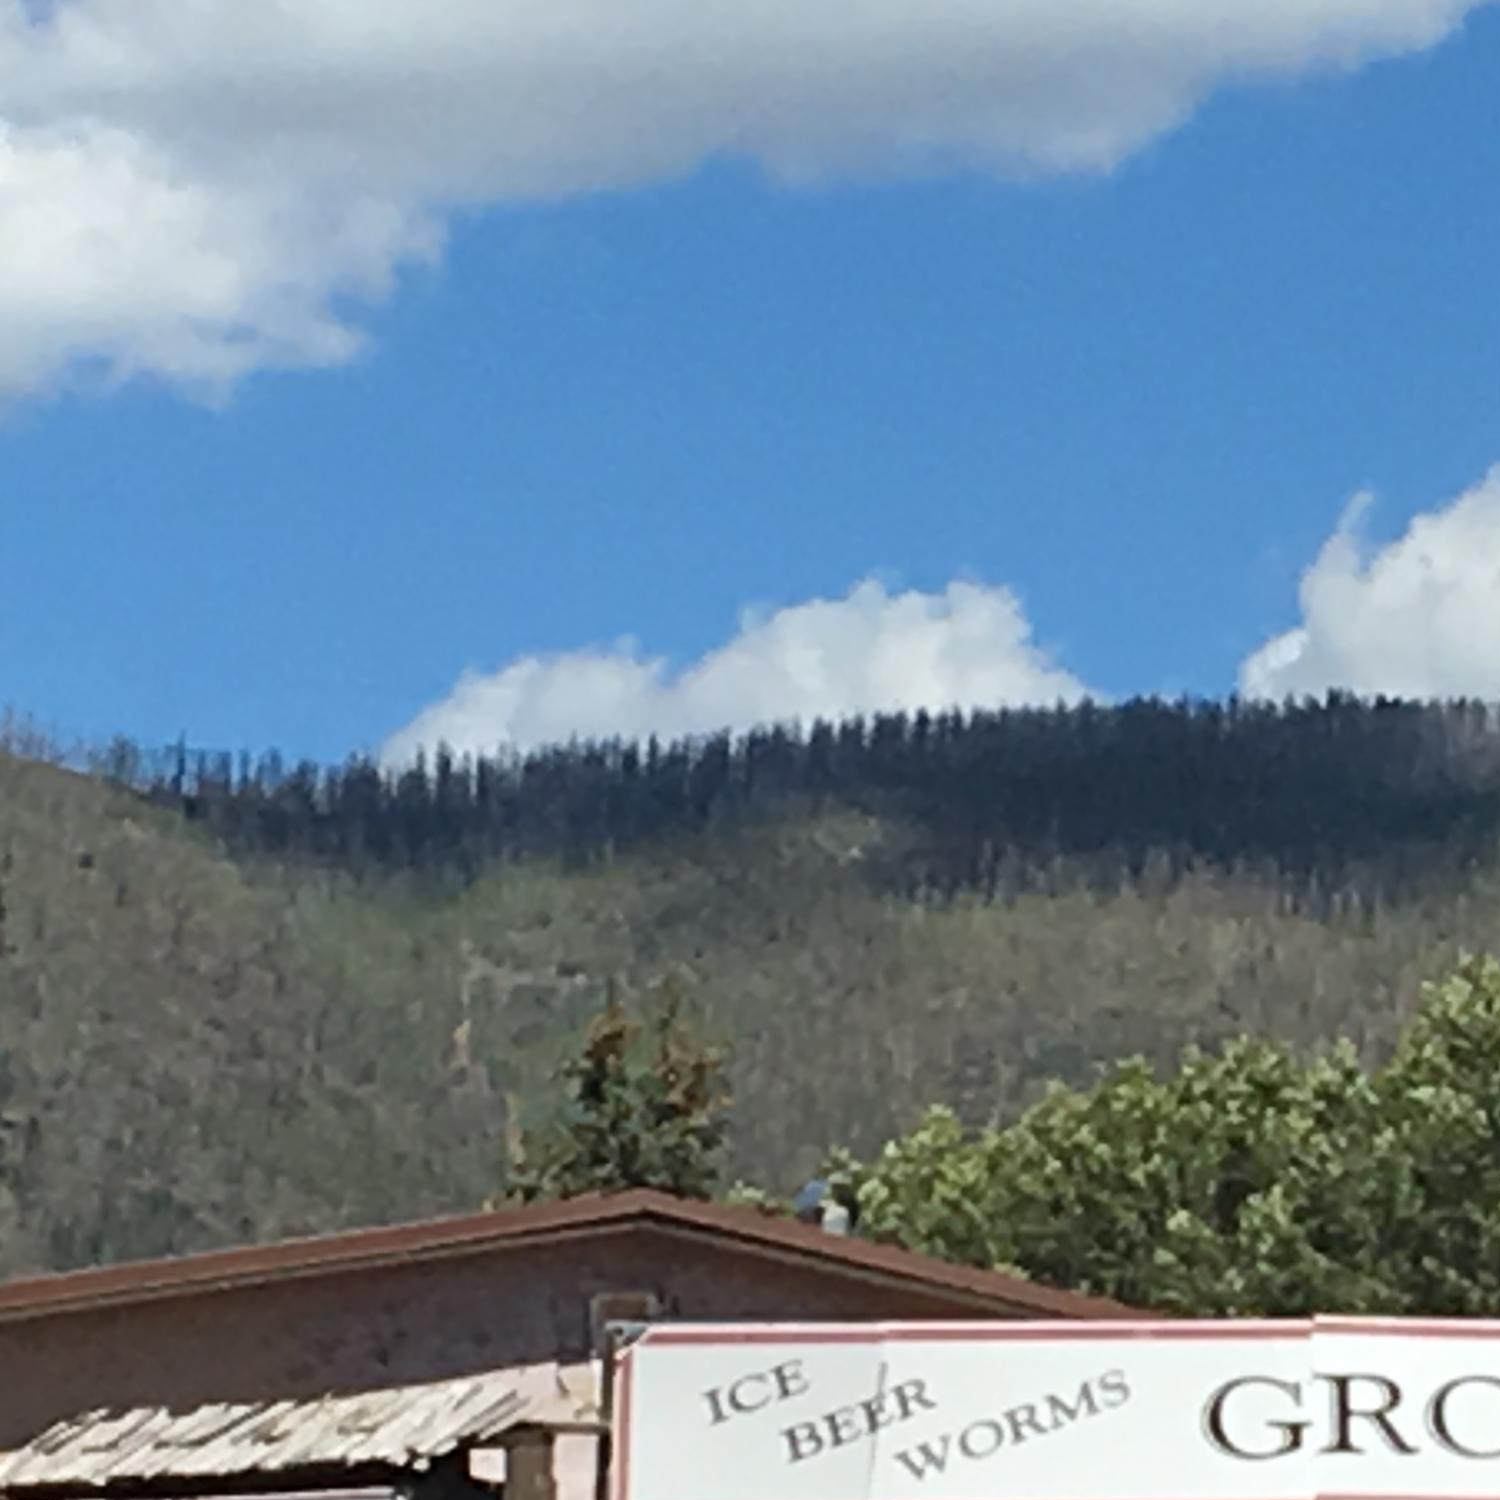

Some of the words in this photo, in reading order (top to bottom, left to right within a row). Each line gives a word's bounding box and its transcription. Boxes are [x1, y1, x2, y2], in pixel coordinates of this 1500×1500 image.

[702, 1358, 811, 1427] ICE
[779, 1377, 937, 1463] BEER
[893, 1368, 1132, 1482] WORMS
